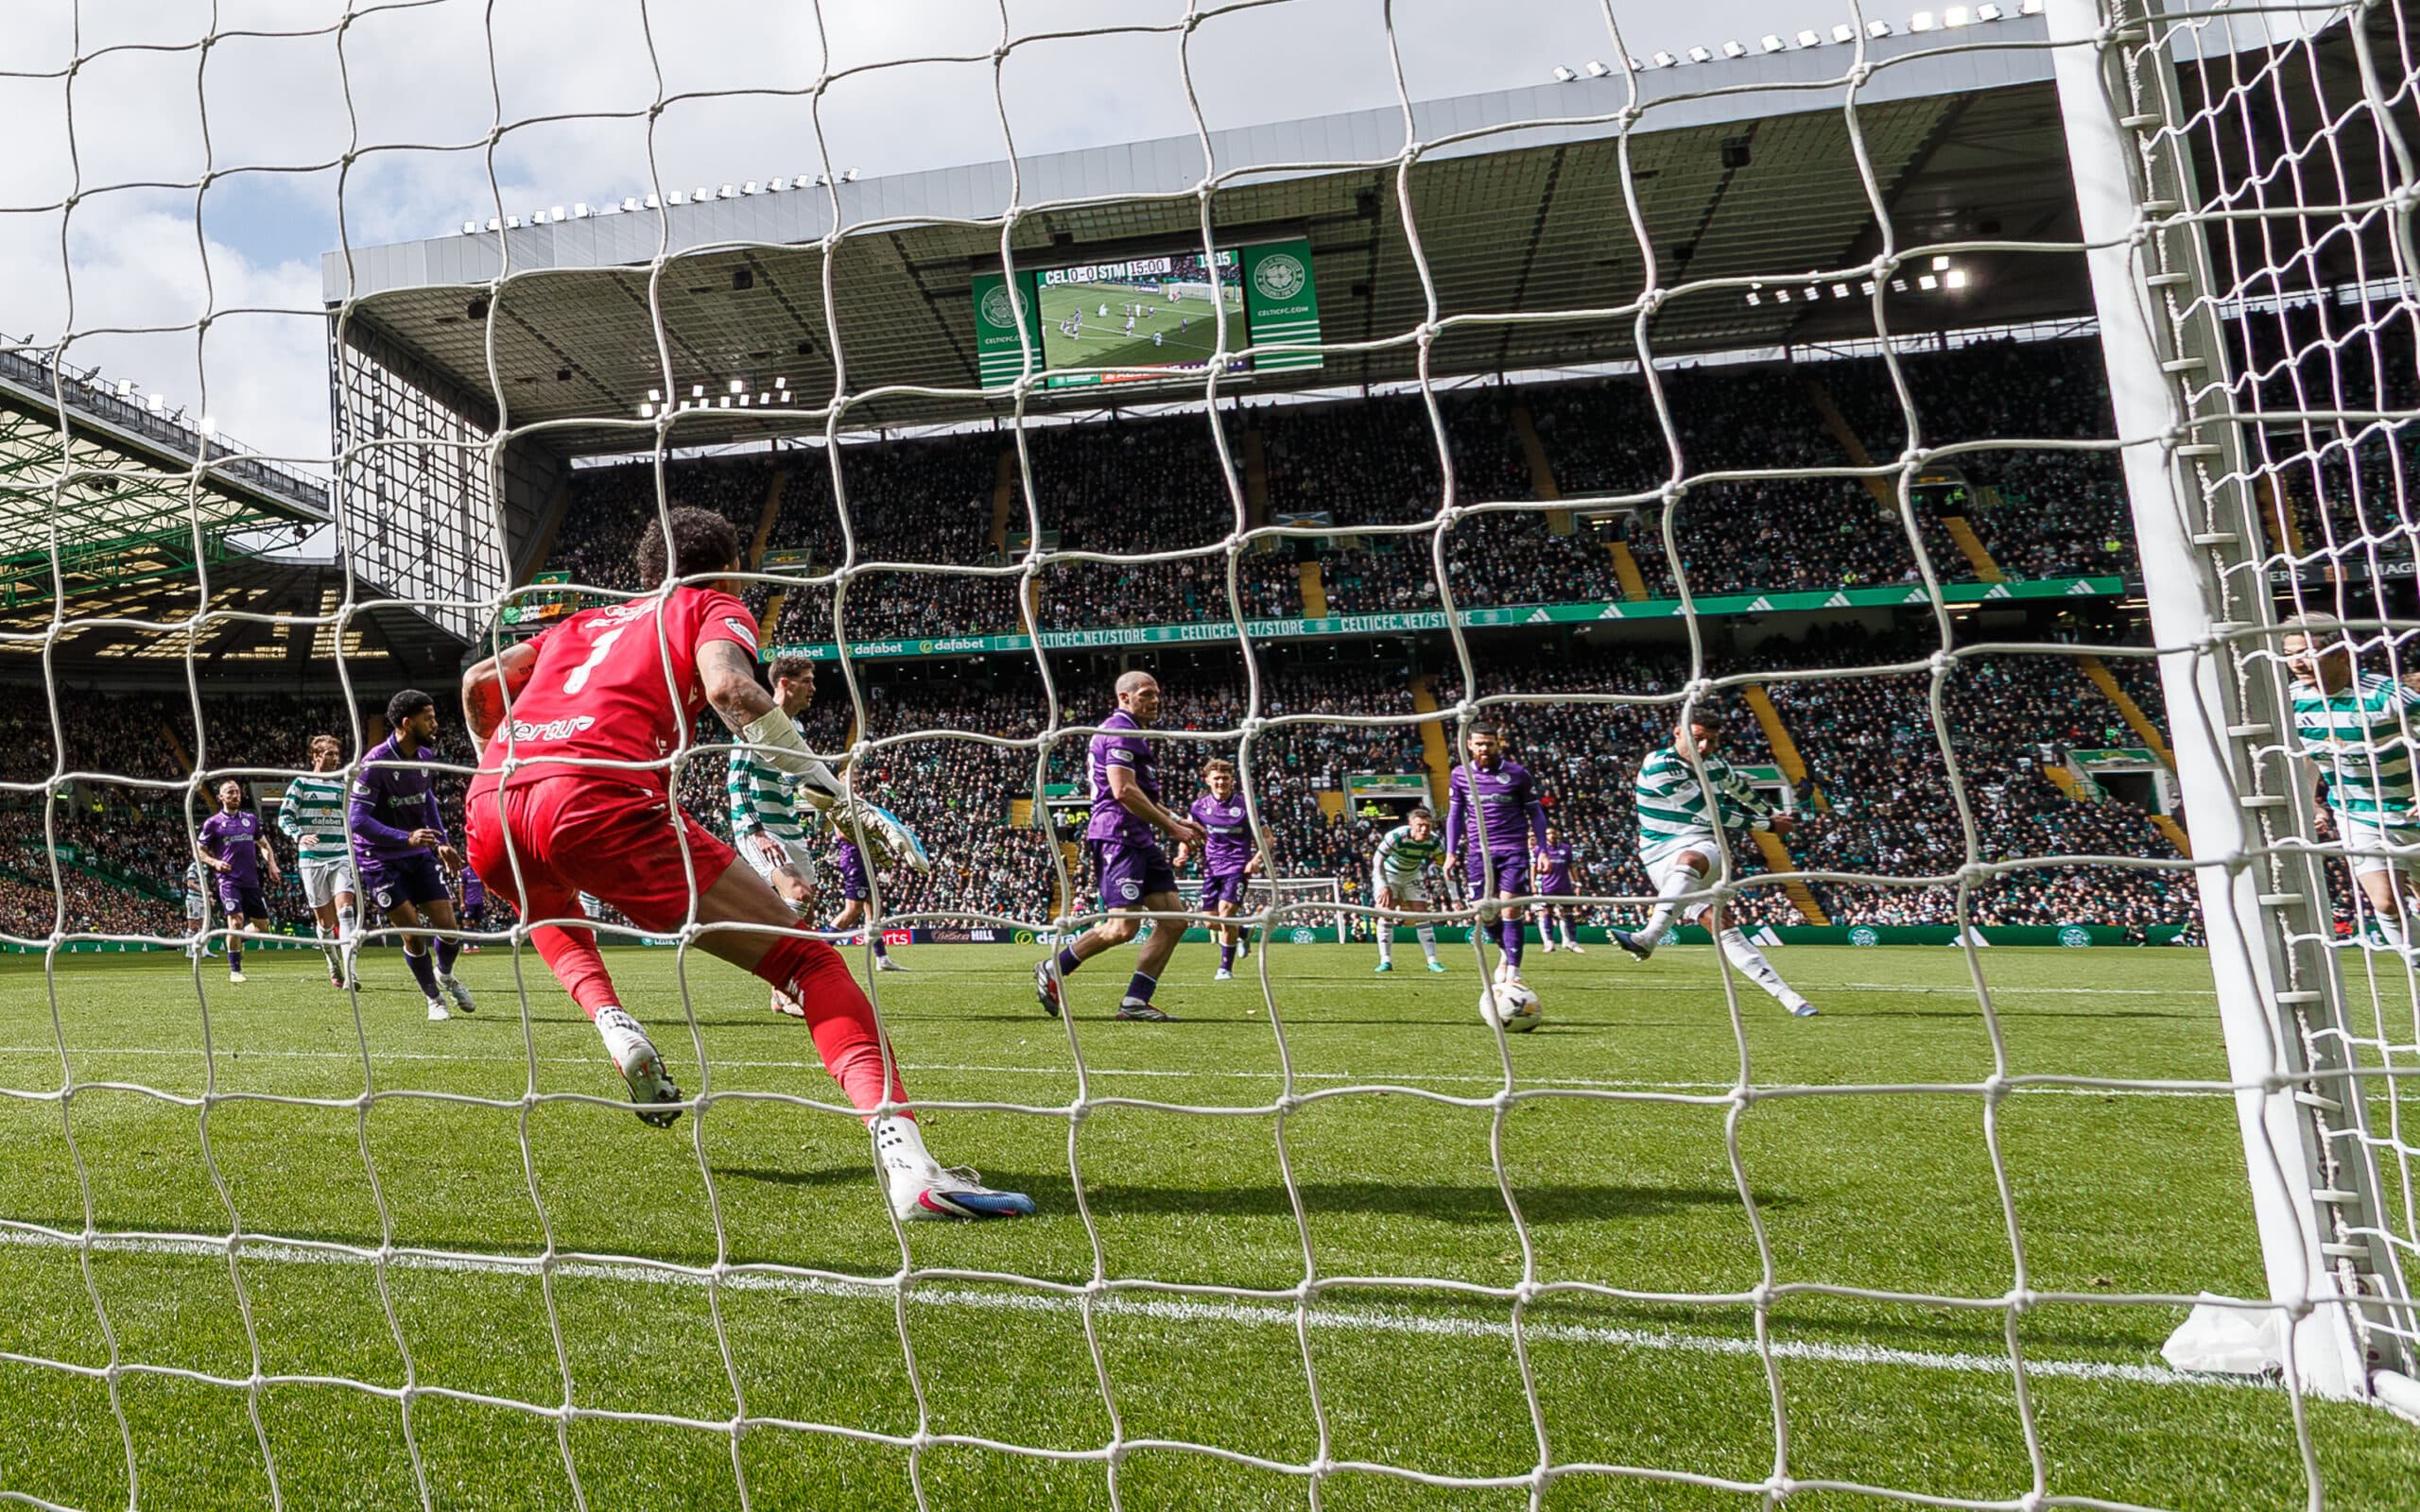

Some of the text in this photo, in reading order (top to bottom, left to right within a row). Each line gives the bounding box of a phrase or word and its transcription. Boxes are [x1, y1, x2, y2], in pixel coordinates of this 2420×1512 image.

[1045, 250, 1231, 284] CEL 0-0 STM 15:00 1:15
[984, 335, 1031, 345] CELTICFC.C
[1037, 611, 1472, 649] ELTICFC.NET/STORE CELTICFC.ET/STORE CELTICFC.NET/STRE
[854, 644, 903, 656] dafabet
[934, 638, 985, 651] dafabet
[856, 932, 908, 945] srts
[971, 929, 995, 941] HILL
